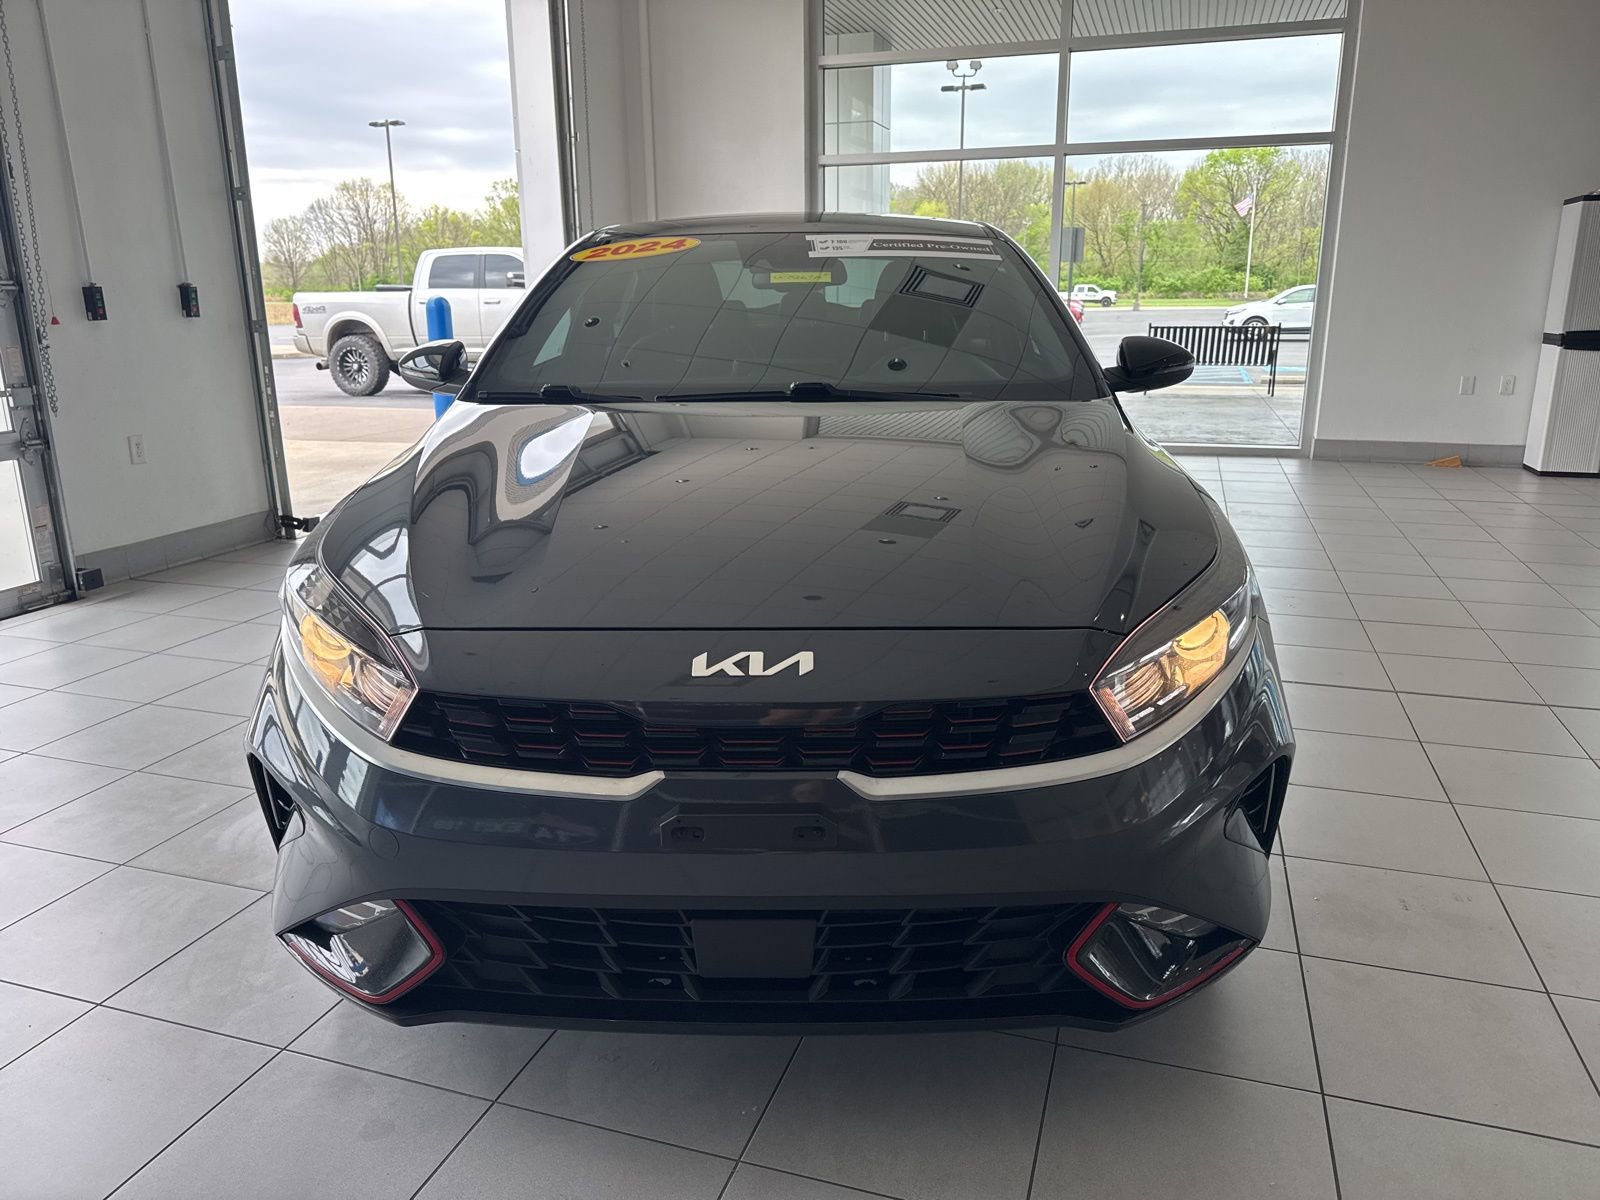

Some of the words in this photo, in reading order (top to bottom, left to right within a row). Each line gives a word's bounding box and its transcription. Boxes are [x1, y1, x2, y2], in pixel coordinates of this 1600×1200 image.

[582, 238, 688, 260] 2024
[872, 240, 924, 248] Certified
[927, 243, 990, 252] Pre-Owned
[692, 651, 815, 678] KIA
